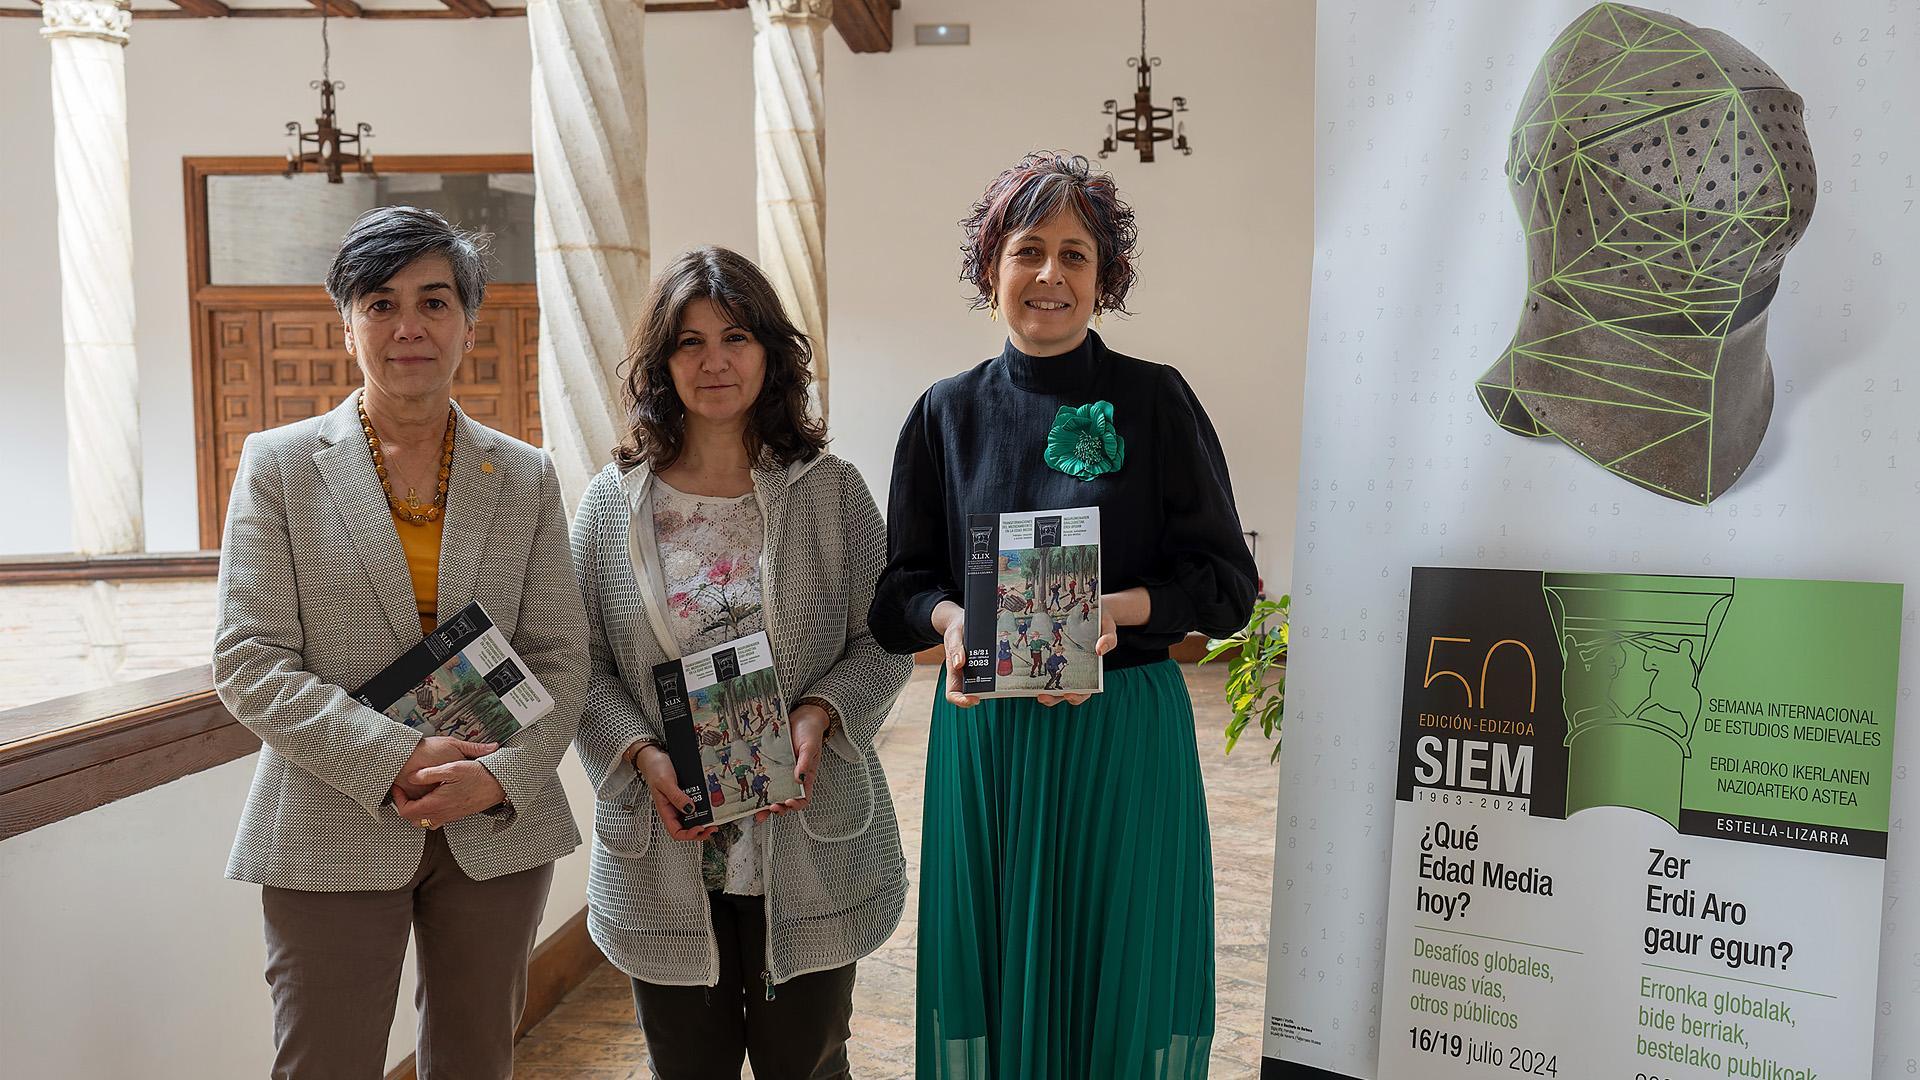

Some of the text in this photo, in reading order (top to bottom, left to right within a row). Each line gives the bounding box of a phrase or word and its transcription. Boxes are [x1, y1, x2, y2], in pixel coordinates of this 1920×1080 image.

[1833, 32, 1842, 45] 6
[1859, 28, 1869, 42] 2
[1486, 56, 1494, 69] 5
[1857, 53, 1867, 67] 6
[1485, 79, 1493, 92] 3
[1464, 104, 1471, 116] 3
[1823, 180, 1832, 193] 8
[1905, 175, 1914, 188] 1
[1904, 200, 1913, 214] 7
[1516, 229, 1526, 243] 8
[1872, 252, 1882, 265] 8
[1842, 304, 1851, 317] 5
[1410, 392, 1418, 404] 4
[1862, 429, 1871, 443] 9
[1330, 480, 1337, 491] 6
[1368, 480, 1375, 491] 8
[1385, 501, 1392, 512] 9
[1610, 503, 1620, 515] 5
[1309, 521, 1316, 532] 5
[1728, 528, 1736, 541] 9
[972, 552, 990, 560] XLIX
[1382, 566, 1389, 577] 6
[1305, 584, 1312, 595] 5
[1360, 608, 1367, 619] 8
[1359, 630, 1366, 641] 3
[968, 659, 989, 667] 2023
[1424, 636, 1537, 713] 50
[1296, 711, 1304, 722] 4
[1709, 698, 1879, 725] SEMANA INTERNACIONAL
[1419, 713, 1535, 737] EDICIÓN-EDIZIOA
[1704, 718, 1881, 747] DE ESTUDIOS MEDIEVALES
[1334, 735, 1341, 747] 8
[1388, 741, 1395, 753] 2
[1414, 735, 1534, 795] SIEM
[1710, 756, 1870, 786] ERDI AROKO IKERLANEN
[1367, 782, 1374, 793] 8
[1717, 778, 1858, 807] NAZIOARTEKO ASTEA
[1290, 816, 1297, 827] 8
[1420, 821, 1479, 851] ¿Qué
[1716, 818, 1849, 846] ESTELLA-LIZARRA
[1288, 837, 1296, 848] 8
[1326, 842, 1334, 854] 2
[1648, 848, 1691, 880] Zer
[1419, 853, 1553, 896] Edad Media
[1287, 879, 1293, 890] 9
[1417, 886, 1471, 921] hoy?
[1646, 884, 1747, 926] Erdi Aro
[1320, 928, 1326, 939] 1
[1282, 943, 1288, 955] 5
[1301, 946, 1308, 958] 6
[1644, 926, 1794, 971] gaur egun?
[1337, 953, 1344, 964] 6
[1414, 937, 1554, 983] Desafíos globales,
[1299, 968, 1306, 979] 4
[1318, 971, 1325, 982] 9
[1371, 982, 1378, 994] 8
[1412, 968, 1506, 1002] nuevas vías,
[1640, 976, 1795, 1028] Erronka globalak,
[1410, 993, 1518, 1029] otros públicos
[1332, 1018, 1339, 1030] 8
[1638, 1005, 1749, 1049] bide berriak,
[1368, 1026, 1375, 1038] 8
[1409, 1027, 1558, 1078] 16/19 julio 2024
[1637, 1034, 1721, 1071] bestelako
[1906, 1059, 1917, 1073] 8
